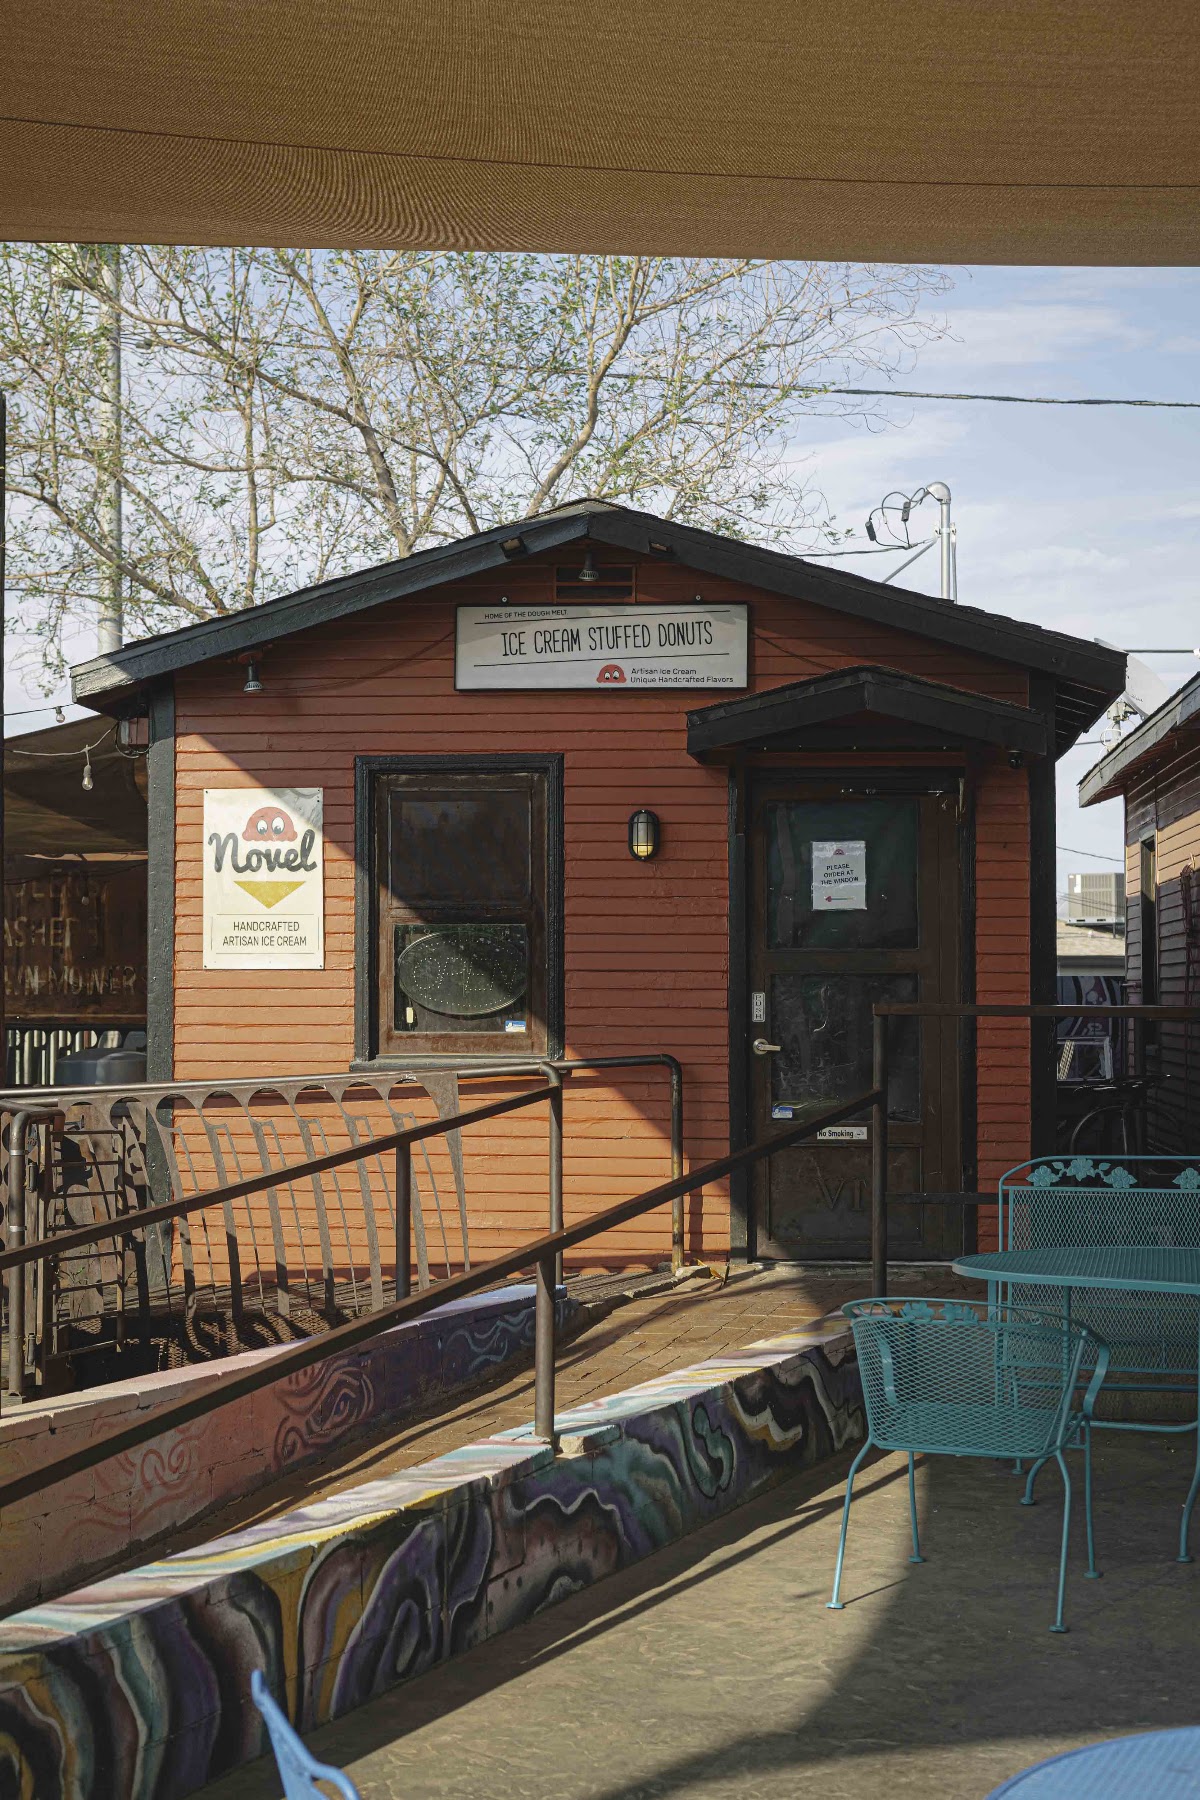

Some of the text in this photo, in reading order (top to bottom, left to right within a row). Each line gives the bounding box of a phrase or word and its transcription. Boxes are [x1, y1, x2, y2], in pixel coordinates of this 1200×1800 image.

[500, 620, 713, 657] ICE CREAM STUFFED DONUTS
[631, 667, 697, 675] Artisan Ice Cream
[630, 675, 734, 684] Unique Handcrafted Flavors
[208, 829, 317, 874] Novel
[826, 863, 850, 871] PLEASE
[833, 876, 859, 885] WINDOW
[233, 921, 300, 932] HANDCRAFTED
[222, 935, 307, 947] ARTISAN ICE CREAM
[412, 957, 519, 992] OPEN
[827, 1129, 854, 1138] Smoking
